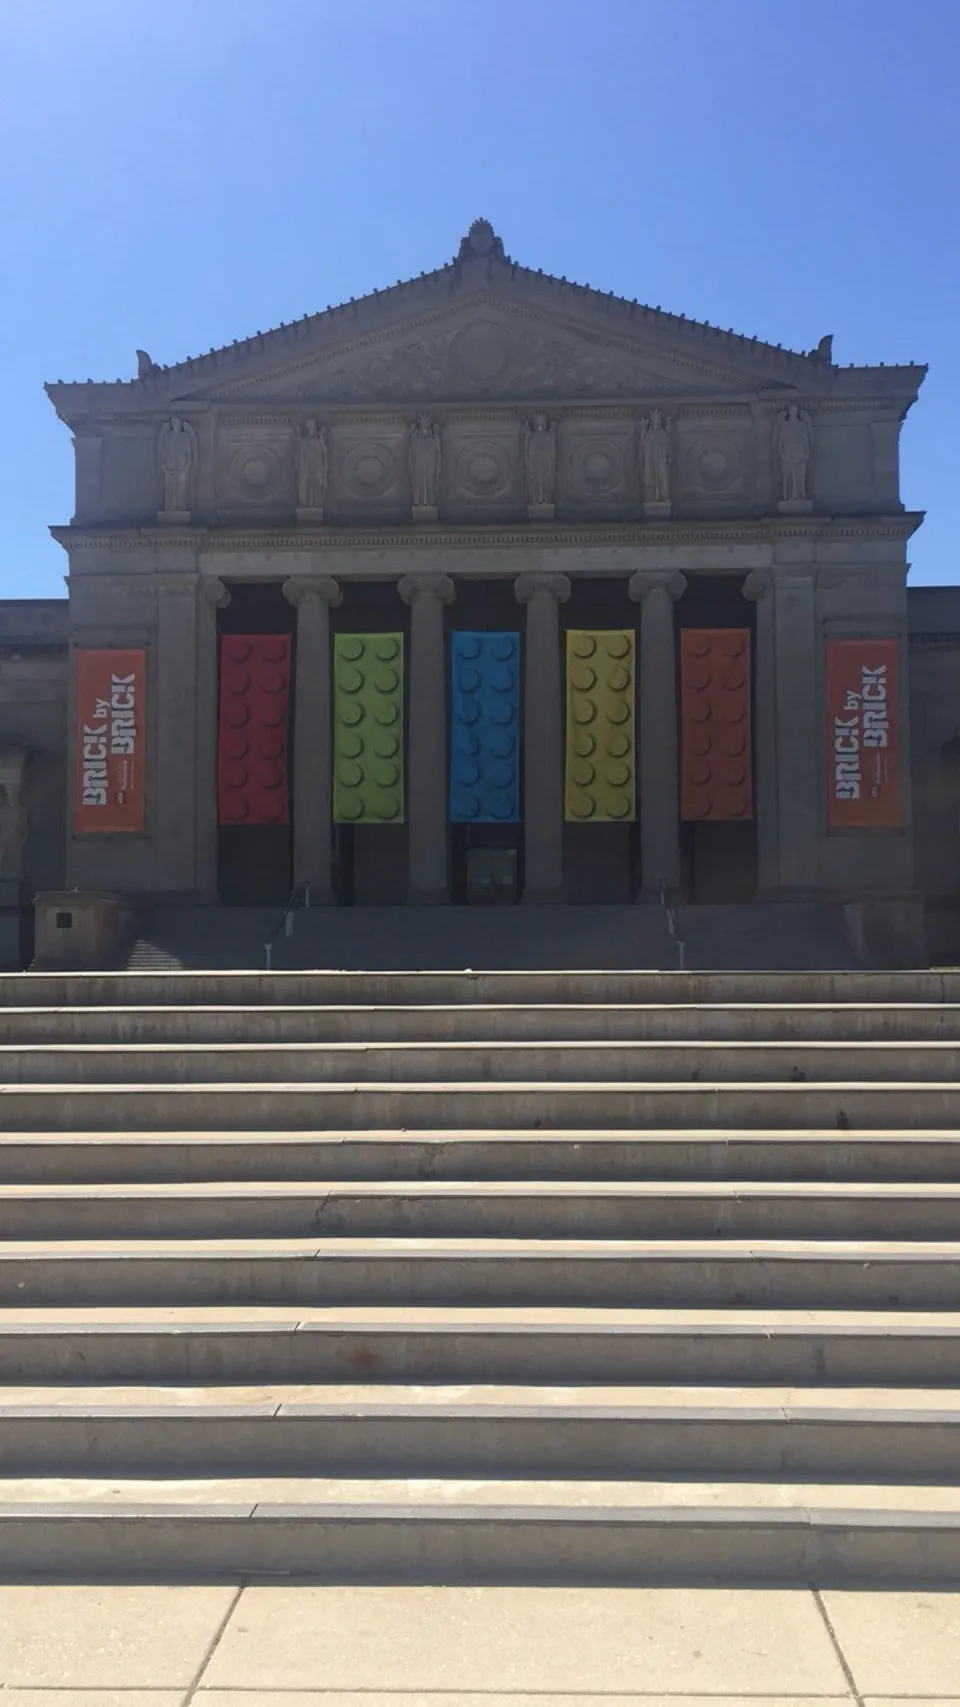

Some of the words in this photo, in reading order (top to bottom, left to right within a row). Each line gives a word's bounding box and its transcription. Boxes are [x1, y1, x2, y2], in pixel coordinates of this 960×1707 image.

[93, 698, 109, 718] by
[111, 674, 136, 754] BRICK
[845, 690, 861, 710] by
[862, 664, 889, 747] BRICK
[83, 724, 107, 804] BRICK
[835, 716, 861, 798] BRICK
